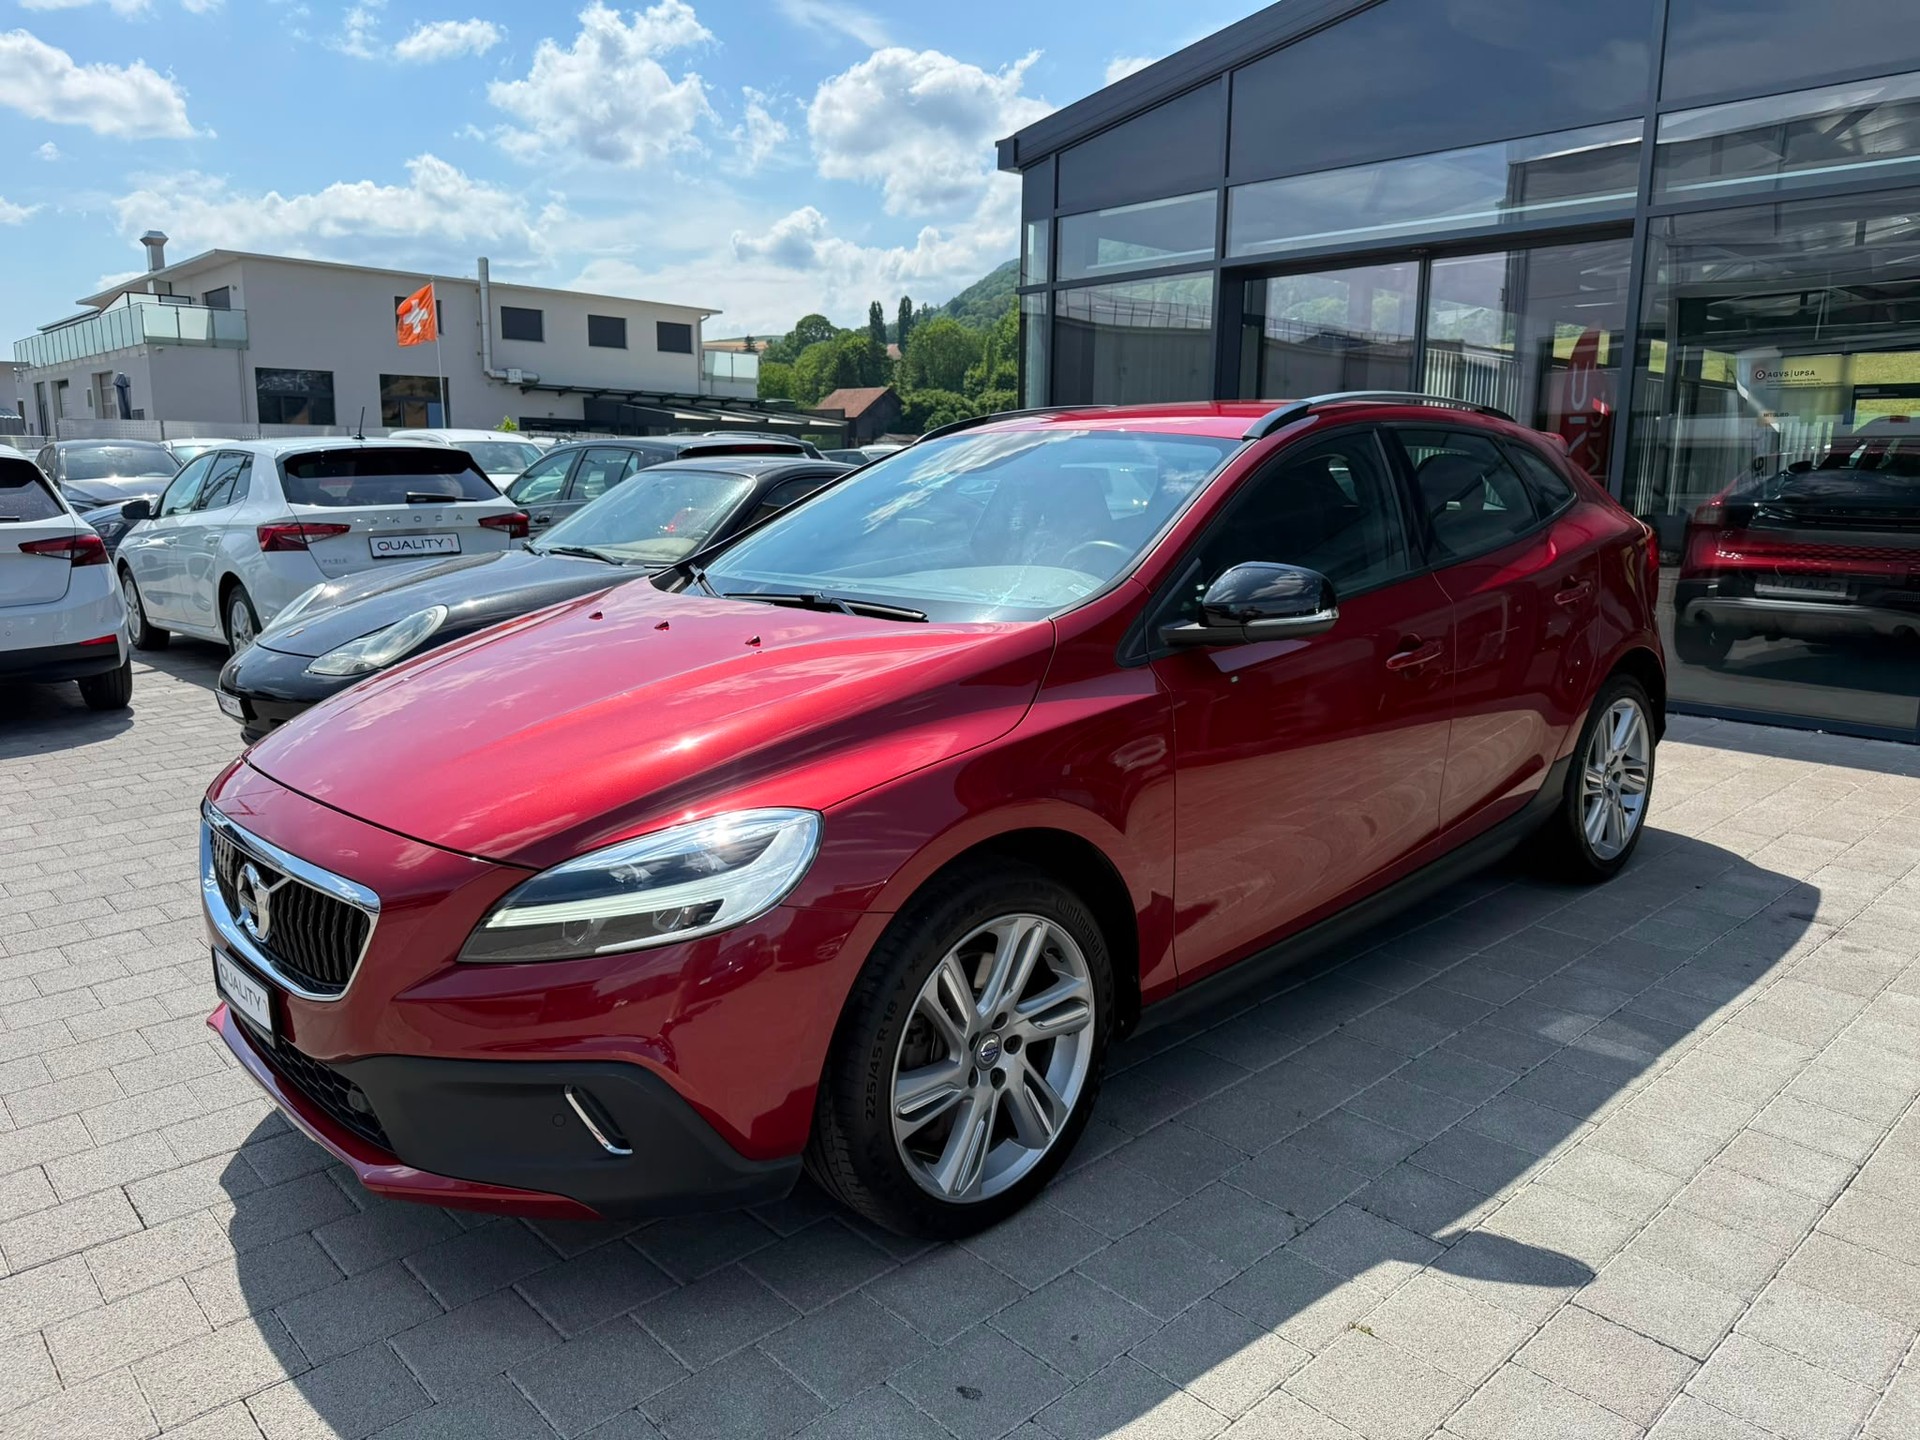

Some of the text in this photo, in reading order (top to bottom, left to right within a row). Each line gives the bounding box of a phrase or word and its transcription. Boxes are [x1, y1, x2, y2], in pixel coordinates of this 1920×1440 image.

[377, 537, 454, 551] QUALITY 1
[219, 962, 261, 1012] QUALITY
[882, 1001, 898, 1023] 18
[877, 1028, 889, 1042] R
[864, 1046, 883, 1120] 225/45
